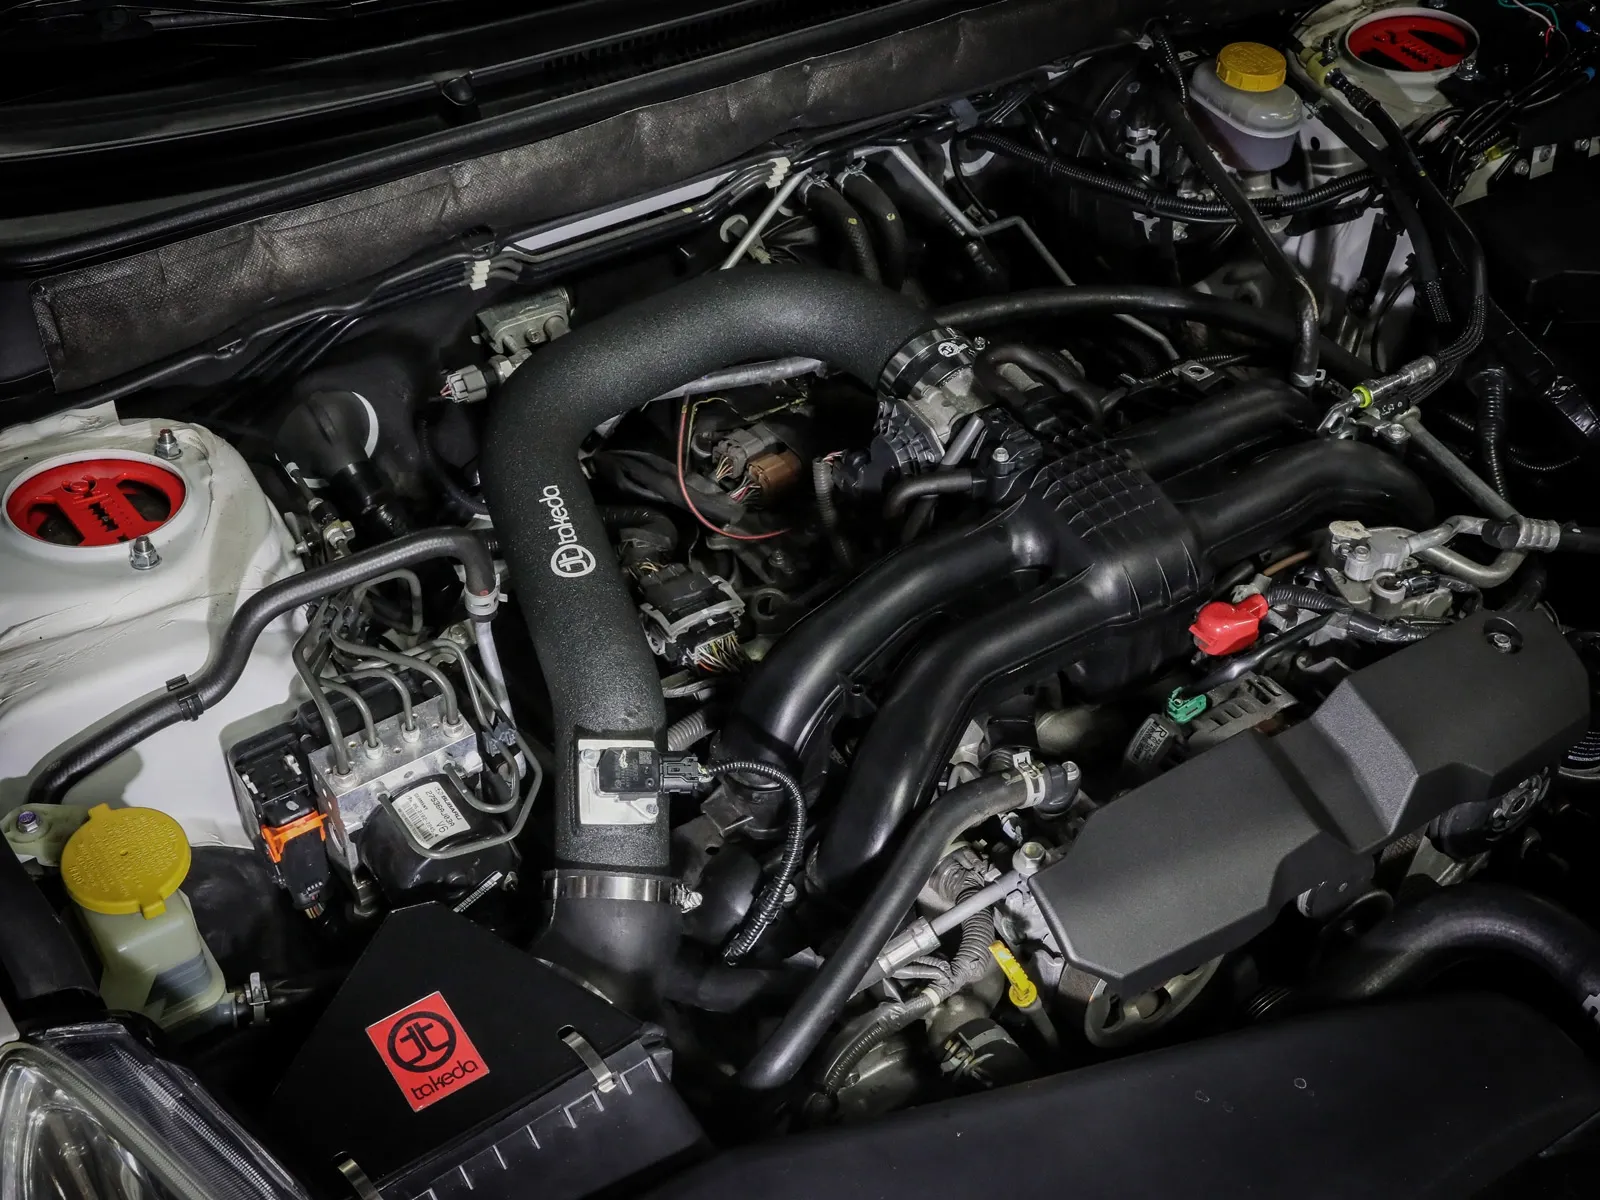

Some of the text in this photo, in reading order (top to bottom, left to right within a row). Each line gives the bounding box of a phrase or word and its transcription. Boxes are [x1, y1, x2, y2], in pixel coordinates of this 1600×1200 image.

[538, 485, 578, 545] takeda
[441, 794, 463, 820] SUBARU
[436, 820, 449, 833] V6
[411, 1060, 479, 1100] takeda
